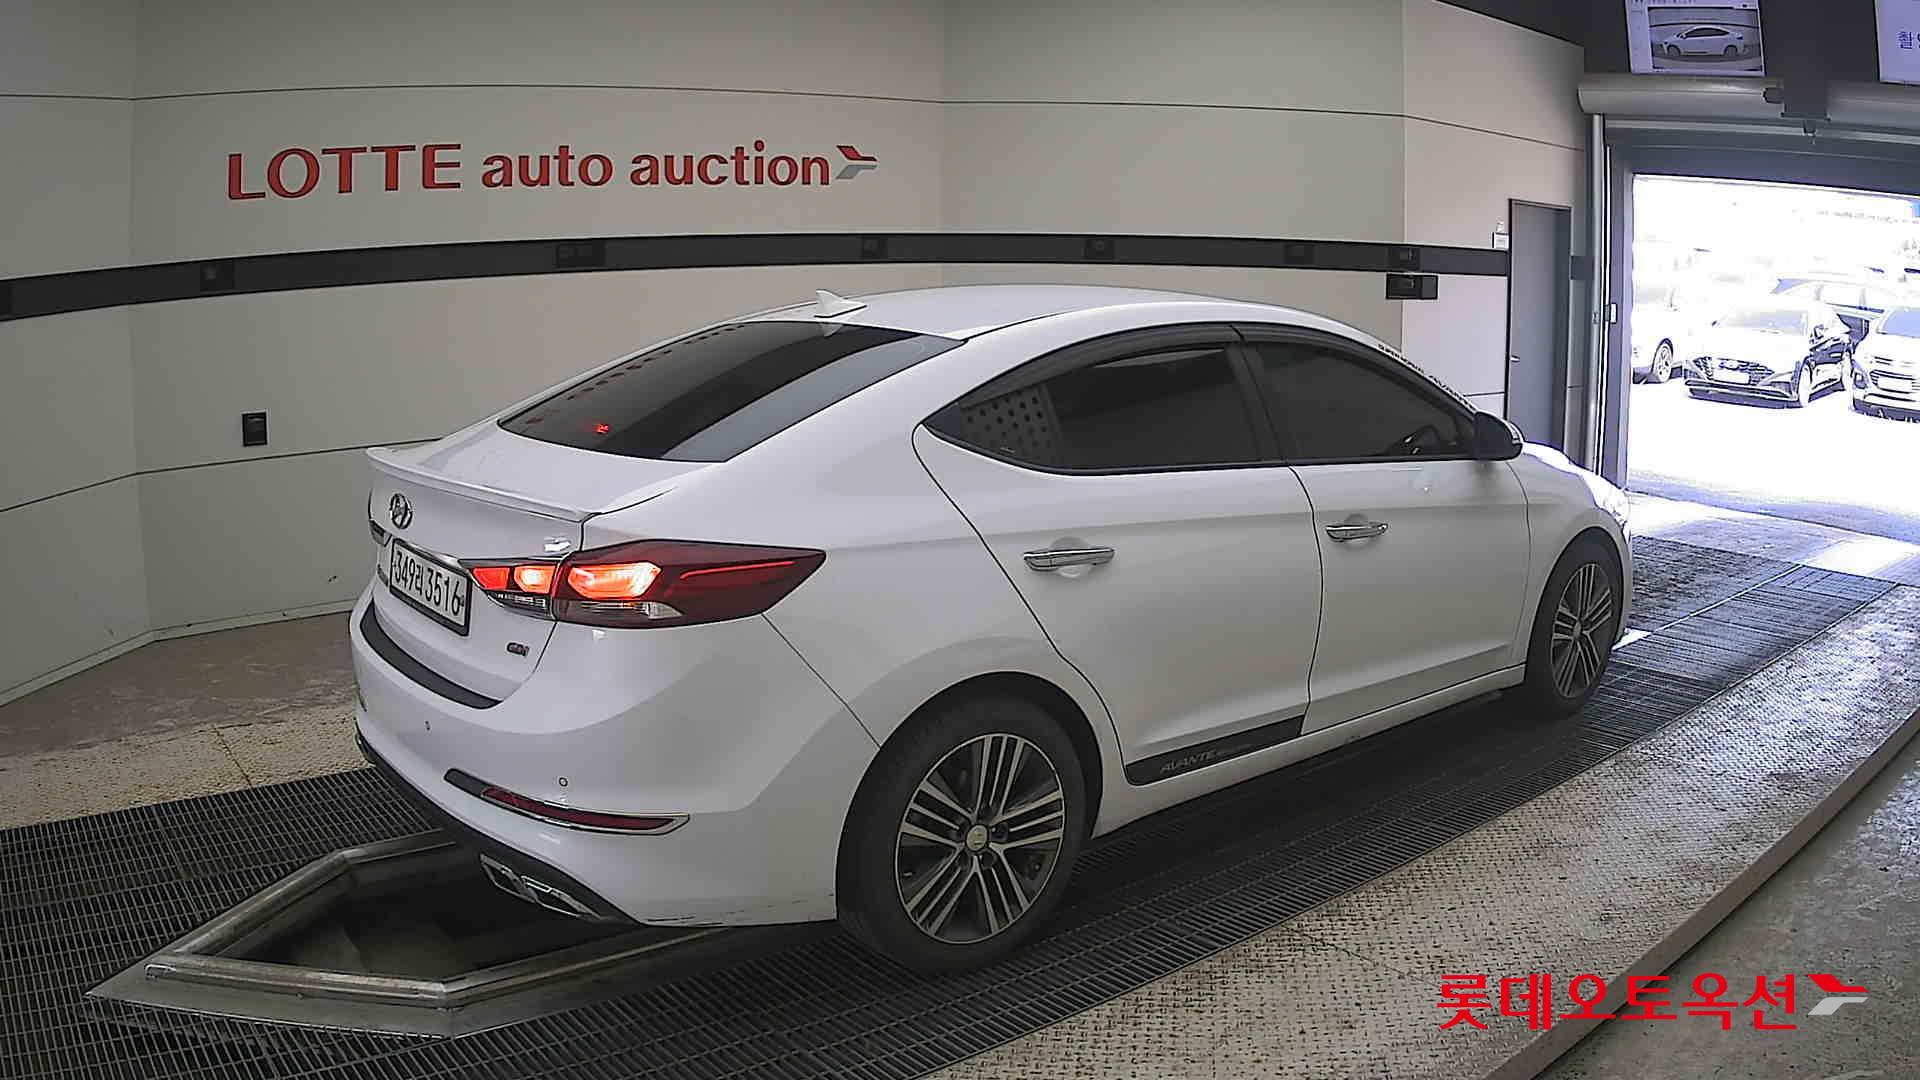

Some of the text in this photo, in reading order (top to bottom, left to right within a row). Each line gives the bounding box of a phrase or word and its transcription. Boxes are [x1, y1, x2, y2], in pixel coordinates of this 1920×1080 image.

[228, 141, 830, 200] LOTTE auto auction
